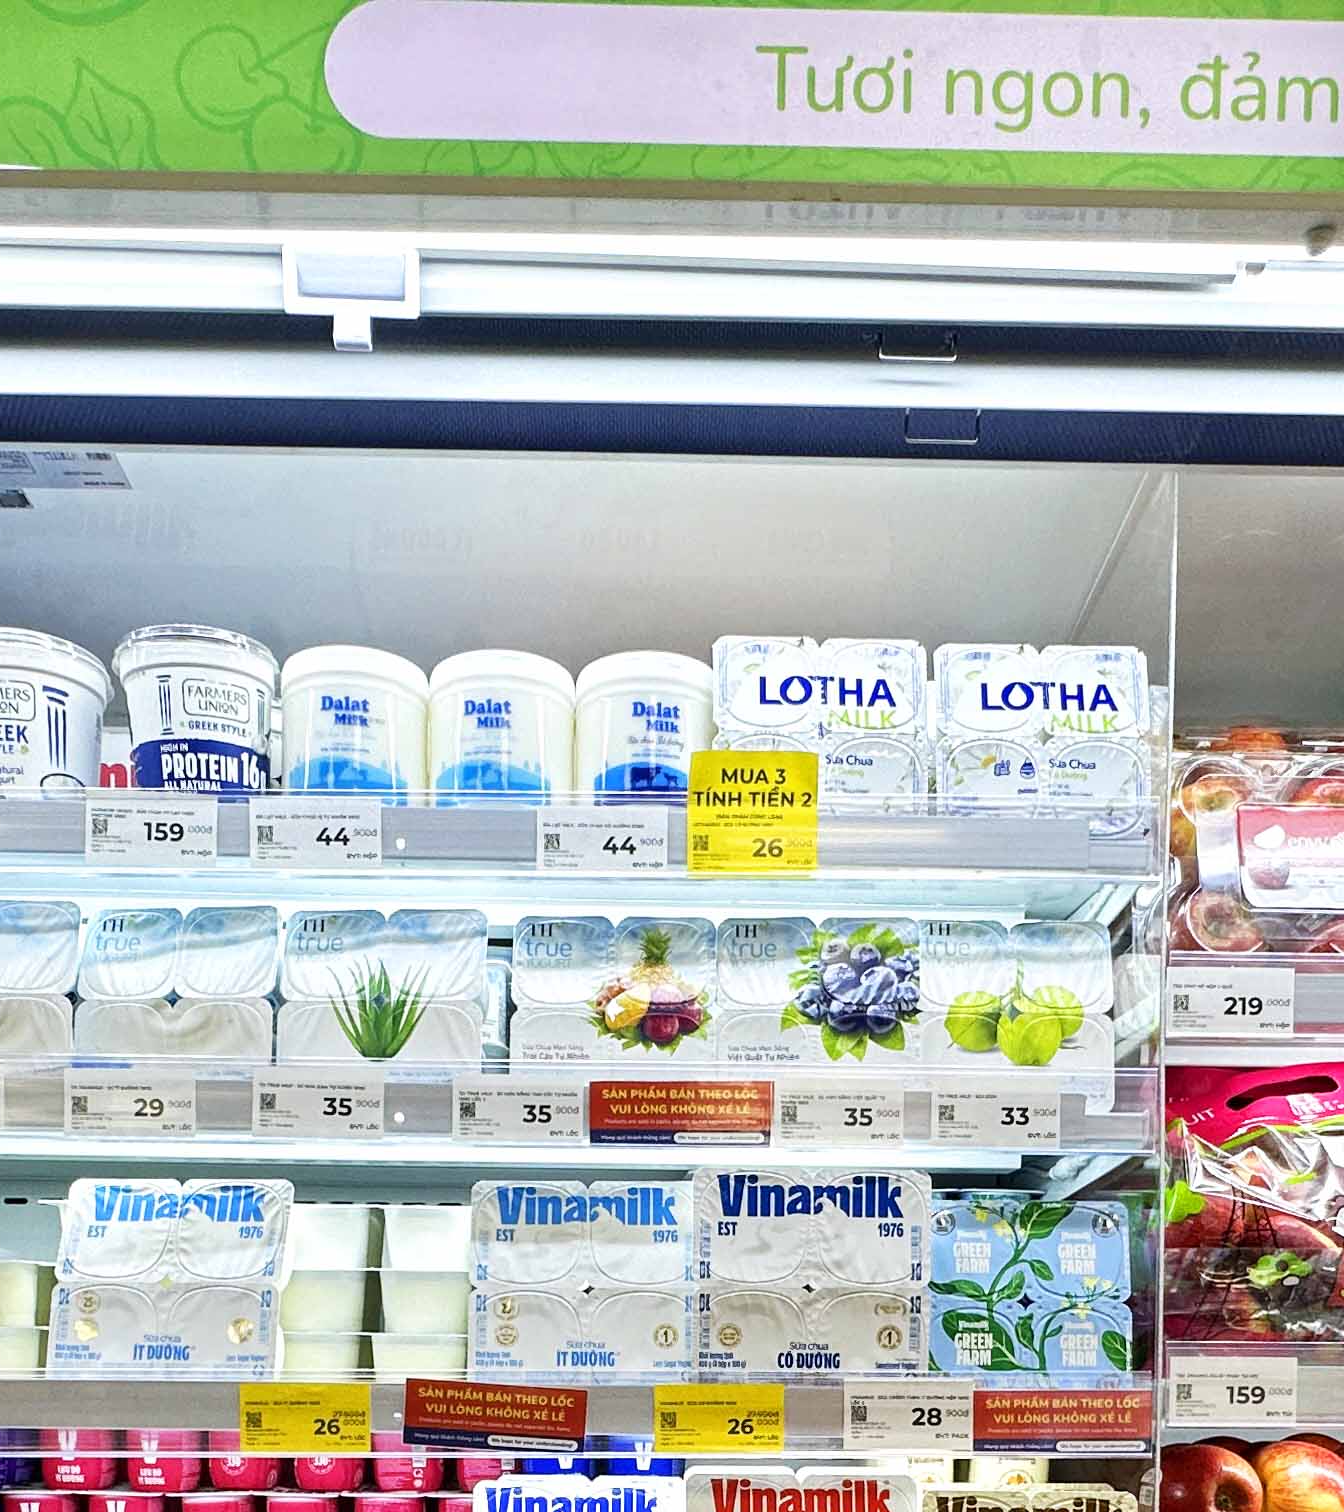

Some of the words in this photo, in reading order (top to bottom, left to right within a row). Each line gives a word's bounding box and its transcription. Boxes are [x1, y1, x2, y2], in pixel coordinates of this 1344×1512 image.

[755, 45, 913, 116] Tươi
[944, 72, 1153, 134] ngon,
[1180, 50, 1341, 126] đảm
[186, 684, 248, 708] FARMERS
[758, 675, 897, 708] LOTHA
[980, 681, 1118, 713] LOTHA
[320, 696, 370, 714] Dalat
[463, 698, 512, 717] Dalat
[334, 712, 370, 728] Milk
[646, 718, 680, 734] Milk
[827, 709, 895, 730] MILK
[160, 751, 237, 781] PROTEIN
[721, 768, 768, 786] MUA
[774, 768, 786, 786] 3
[694, 787, 743, 808] TÍNH
[748, 785, 795, 808] TIỀN
[801, 790, 813, 808] 2
[602, 1085, 627, 1100] SẢN
[672, 1086, 696, 1100] BÁN
[699, 1088, 730, 1100] THEO
[610, 1103, 630, 1115] VUI
[633, 1102, 667, 1115] LÒNG
[670, 1101, 711, 1115] KHÔNG
[496, 1185, 678, 1227] Vinamilk
[717, 1173, 904, 1219] Vinamilk
[87, 1226, 107, 1238] EST
[237, 1225, 264, 1239] 1976
[717, 1222, 737, 1237] EST
[877, 1222, 905, 1238] 1976
